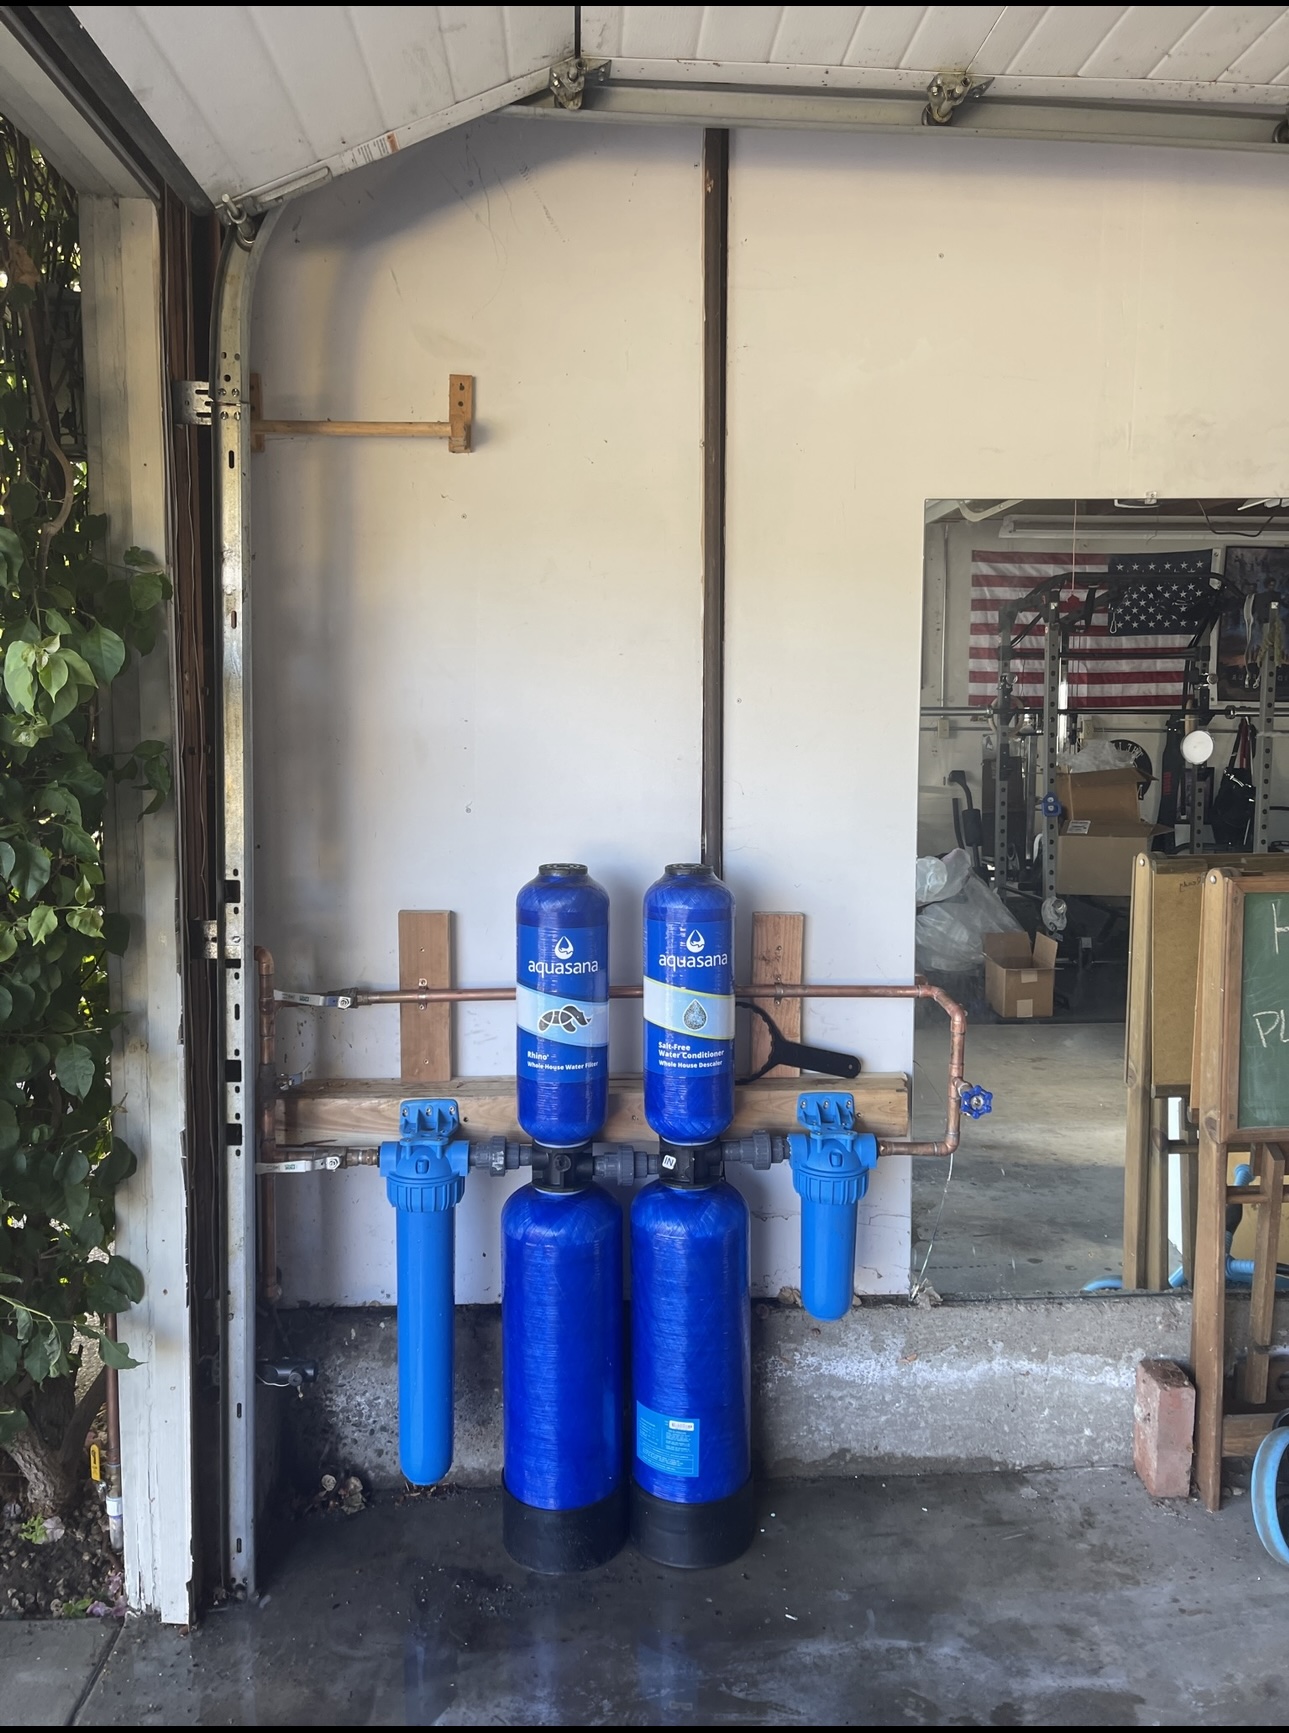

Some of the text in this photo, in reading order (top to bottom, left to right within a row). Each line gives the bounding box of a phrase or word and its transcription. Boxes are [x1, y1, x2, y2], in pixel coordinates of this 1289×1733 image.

[658, 953, 728, 972] aquasana
[528, 960, 599, 978] aquasana
[658, 1041, 691, 1051] Salt-Free
[658, 1049, 725, 1059] Water Conditioner
[526, 1061, 544, 1069] Whole
[544, 1063, 564, 1072] House
[564, 1063, 584, 1071] Water
[658, 1059, 677, 1068] Whole
[698, 1060, 723, 1068] Descaler
[663, 1156, 675, 1167] IN
